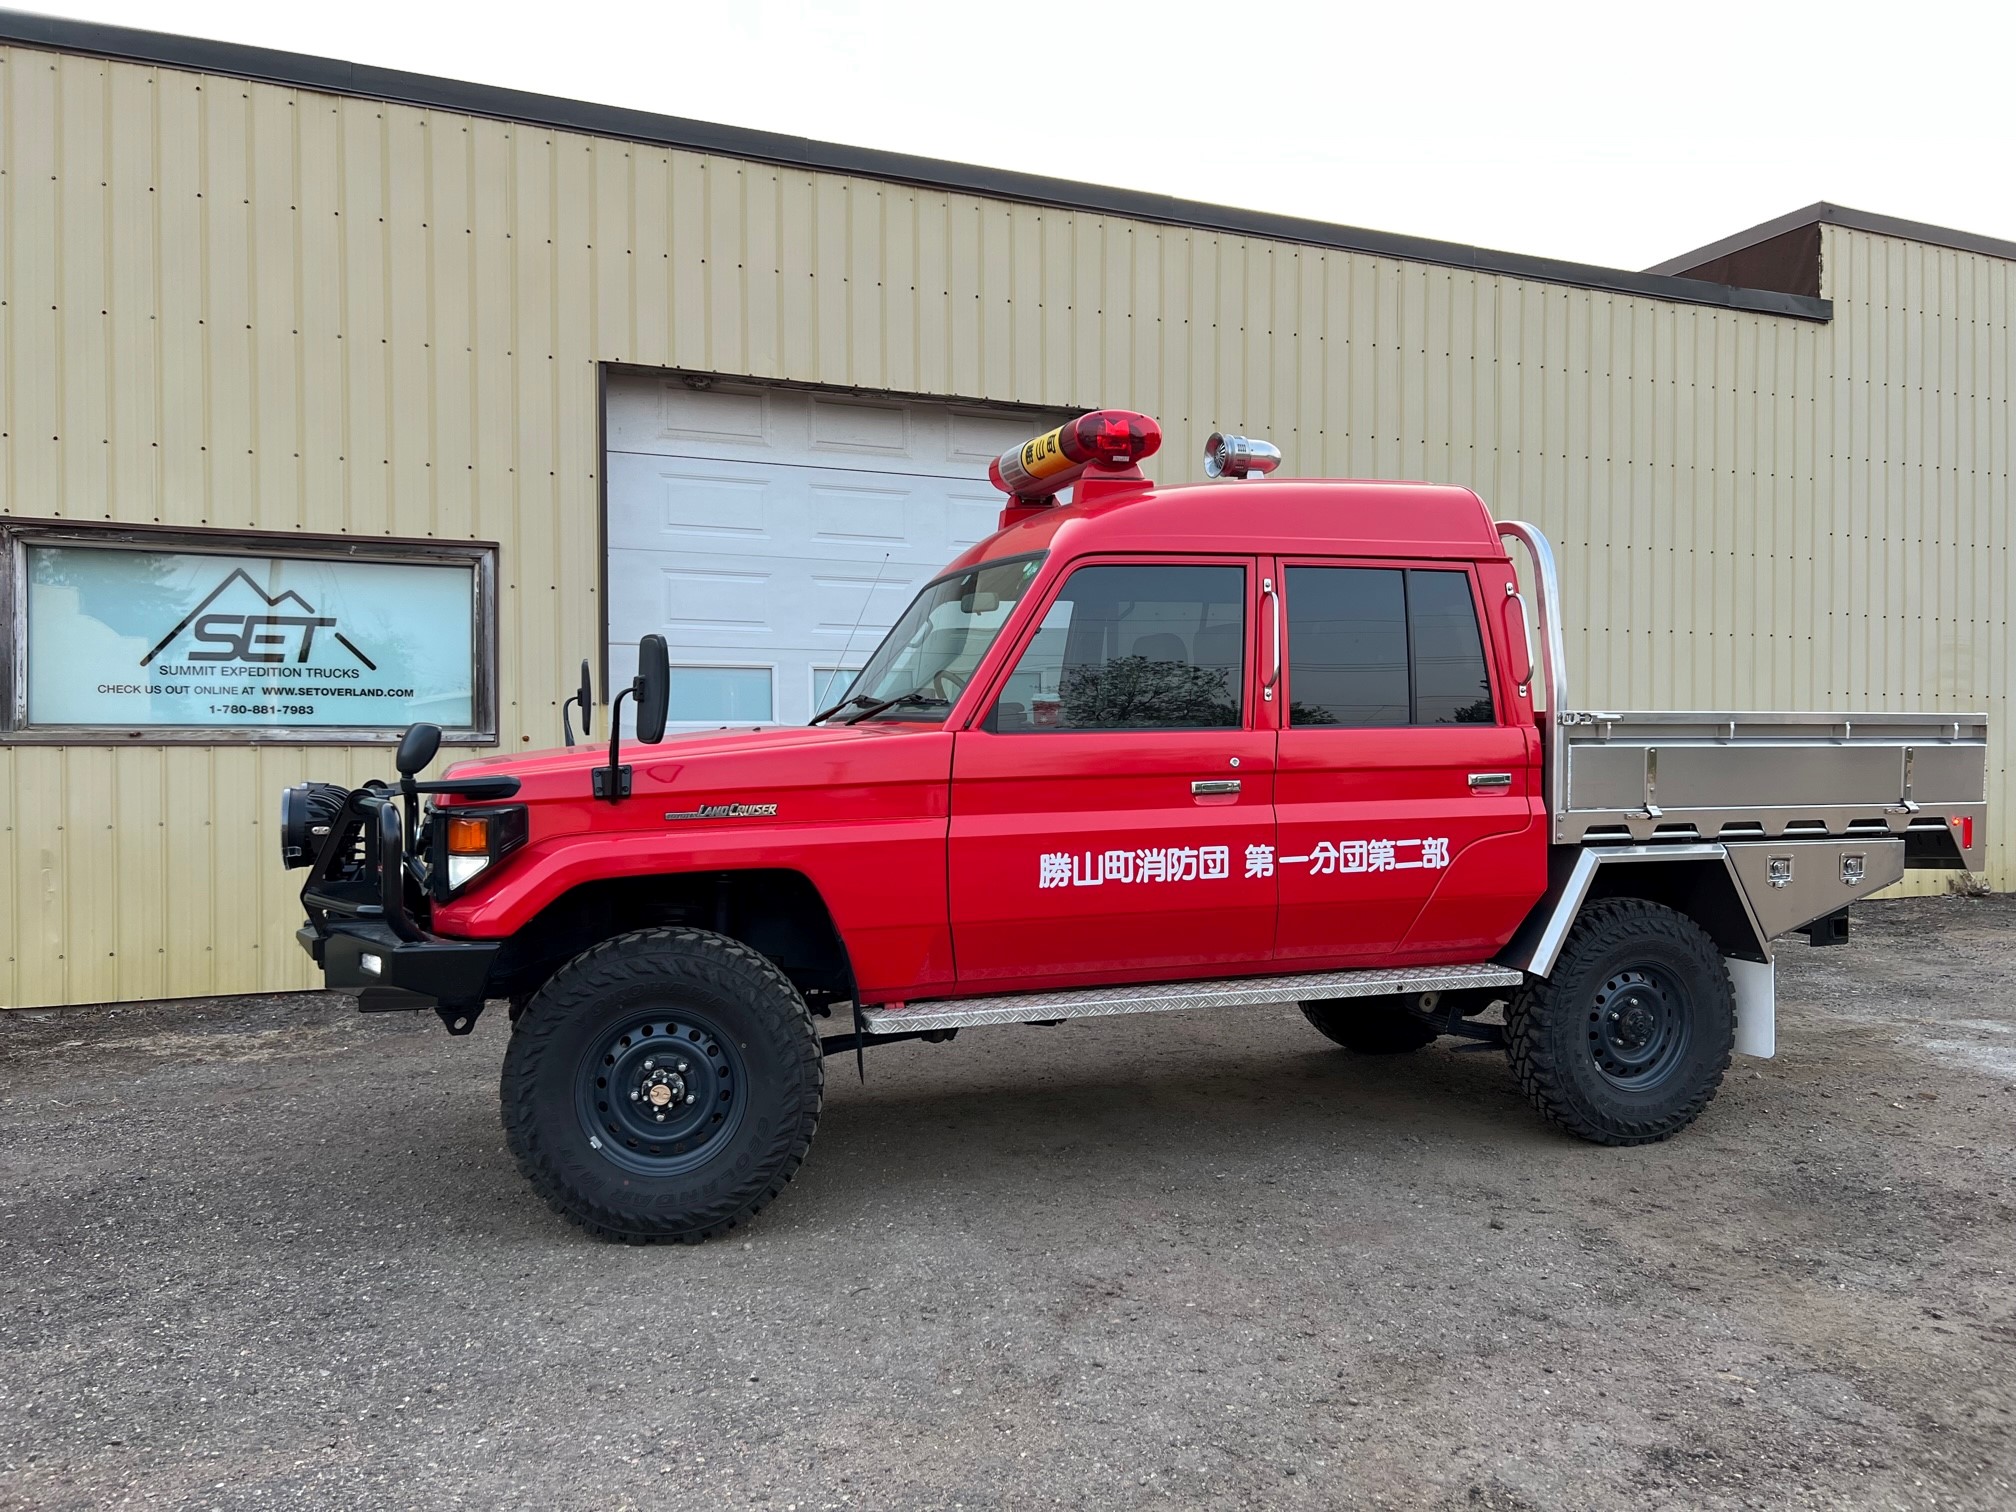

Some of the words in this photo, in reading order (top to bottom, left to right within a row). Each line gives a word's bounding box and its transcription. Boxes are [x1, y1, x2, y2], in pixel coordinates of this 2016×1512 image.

[188, 614, 337, 663] SET
[159, 665, 216, 676] SUMMIT
[221, 666, 301, 677] EXPEDITION
[306, 668, 360, 679] TRUCKS
[97, 684, 141, 694] CHECK
[145, 685, 162, 694] US
[165, 685, 190, 695] OUT
[194, 686, 239, 695] ONLINE
[242, 686, 256, 695] AT
[262, 687, 414, 697] WWW.SETOVERLAND.COM
[209, 705, 314, 715] 1-780-881-7983
[1038, 845, 1230, 888] 勝山町消防団
[1244, 837, 1450, 879] 第一分団第二部
